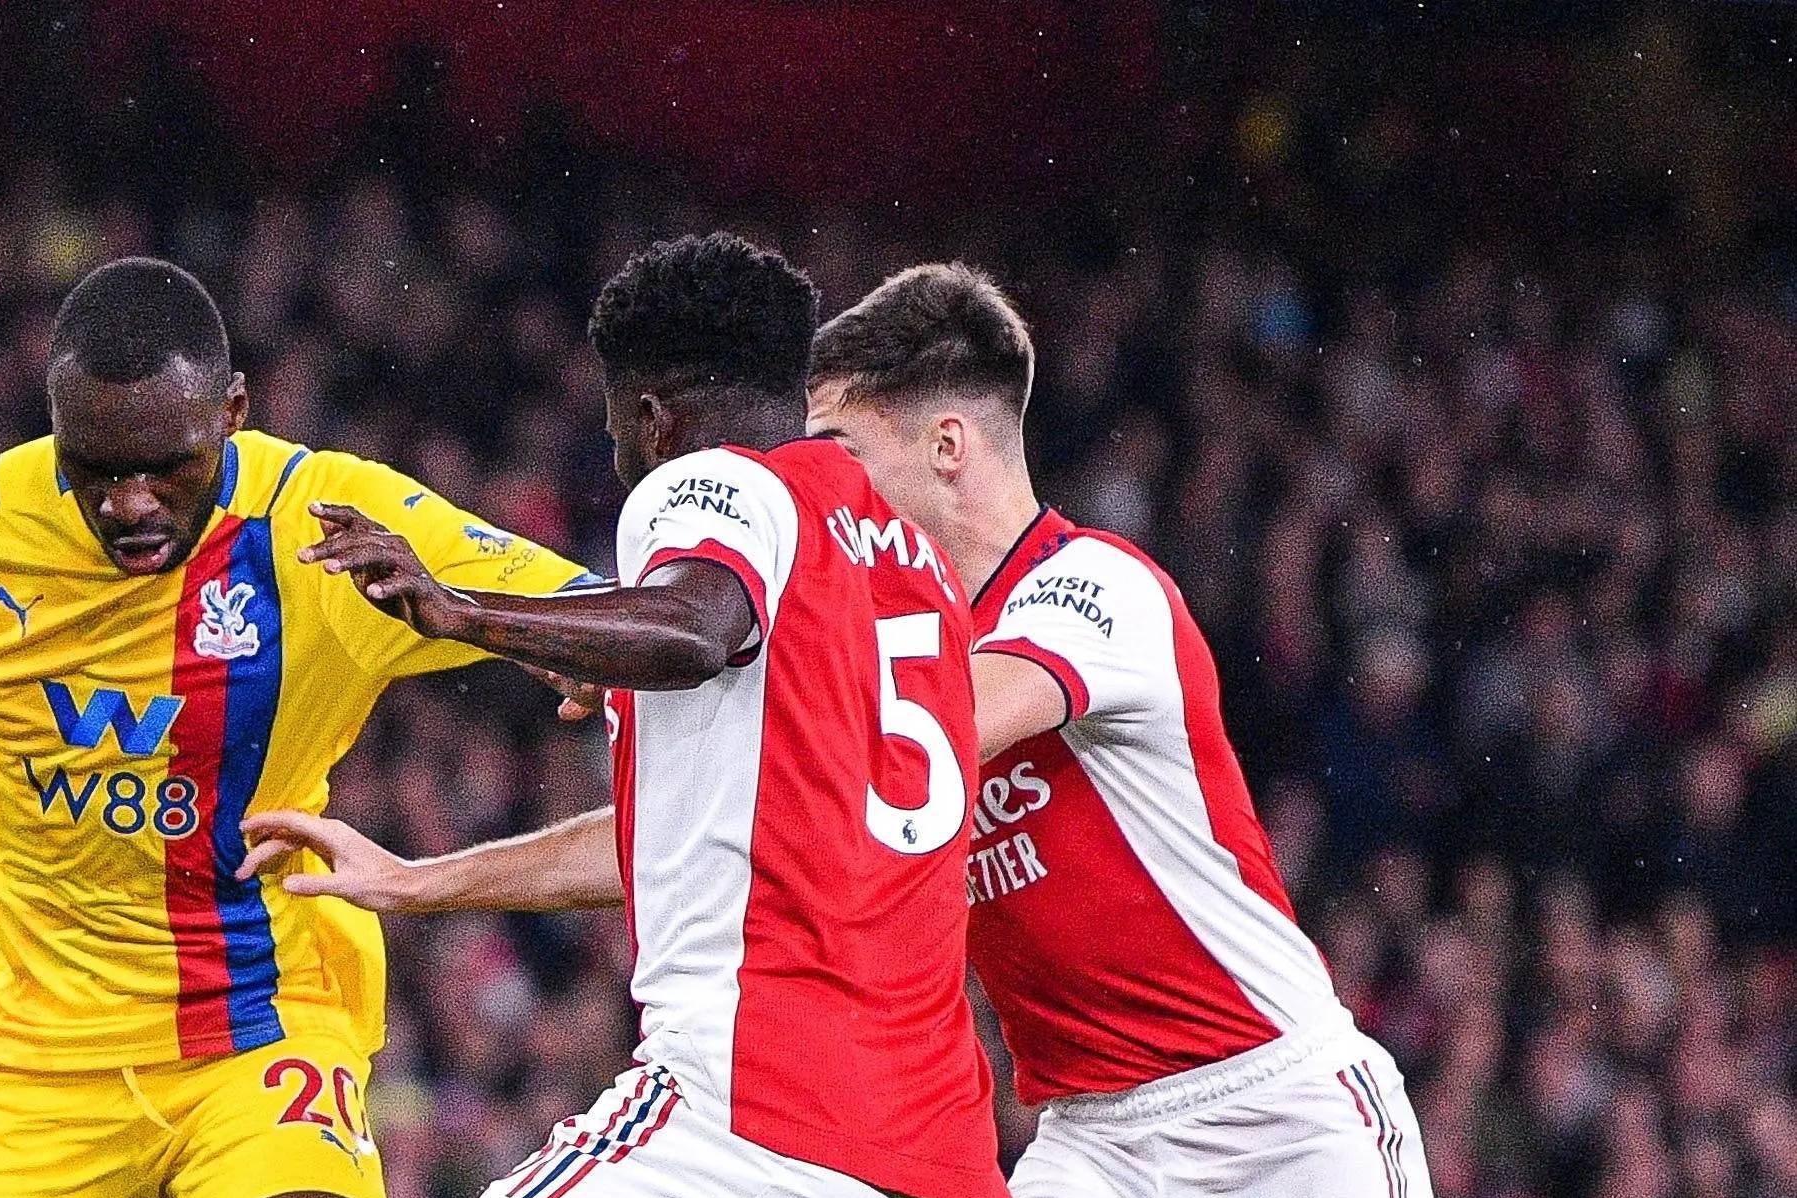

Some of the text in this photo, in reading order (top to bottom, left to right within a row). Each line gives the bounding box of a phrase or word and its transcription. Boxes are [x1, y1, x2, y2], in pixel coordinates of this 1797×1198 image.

[667, 478, 740, 500] VISIT
[1036, 576, 1105, 598] VISIT
[865, 611, 966, 856] 5
[22, 755, 199, 840] W88
[264, 1058, 369, 1141] 20
